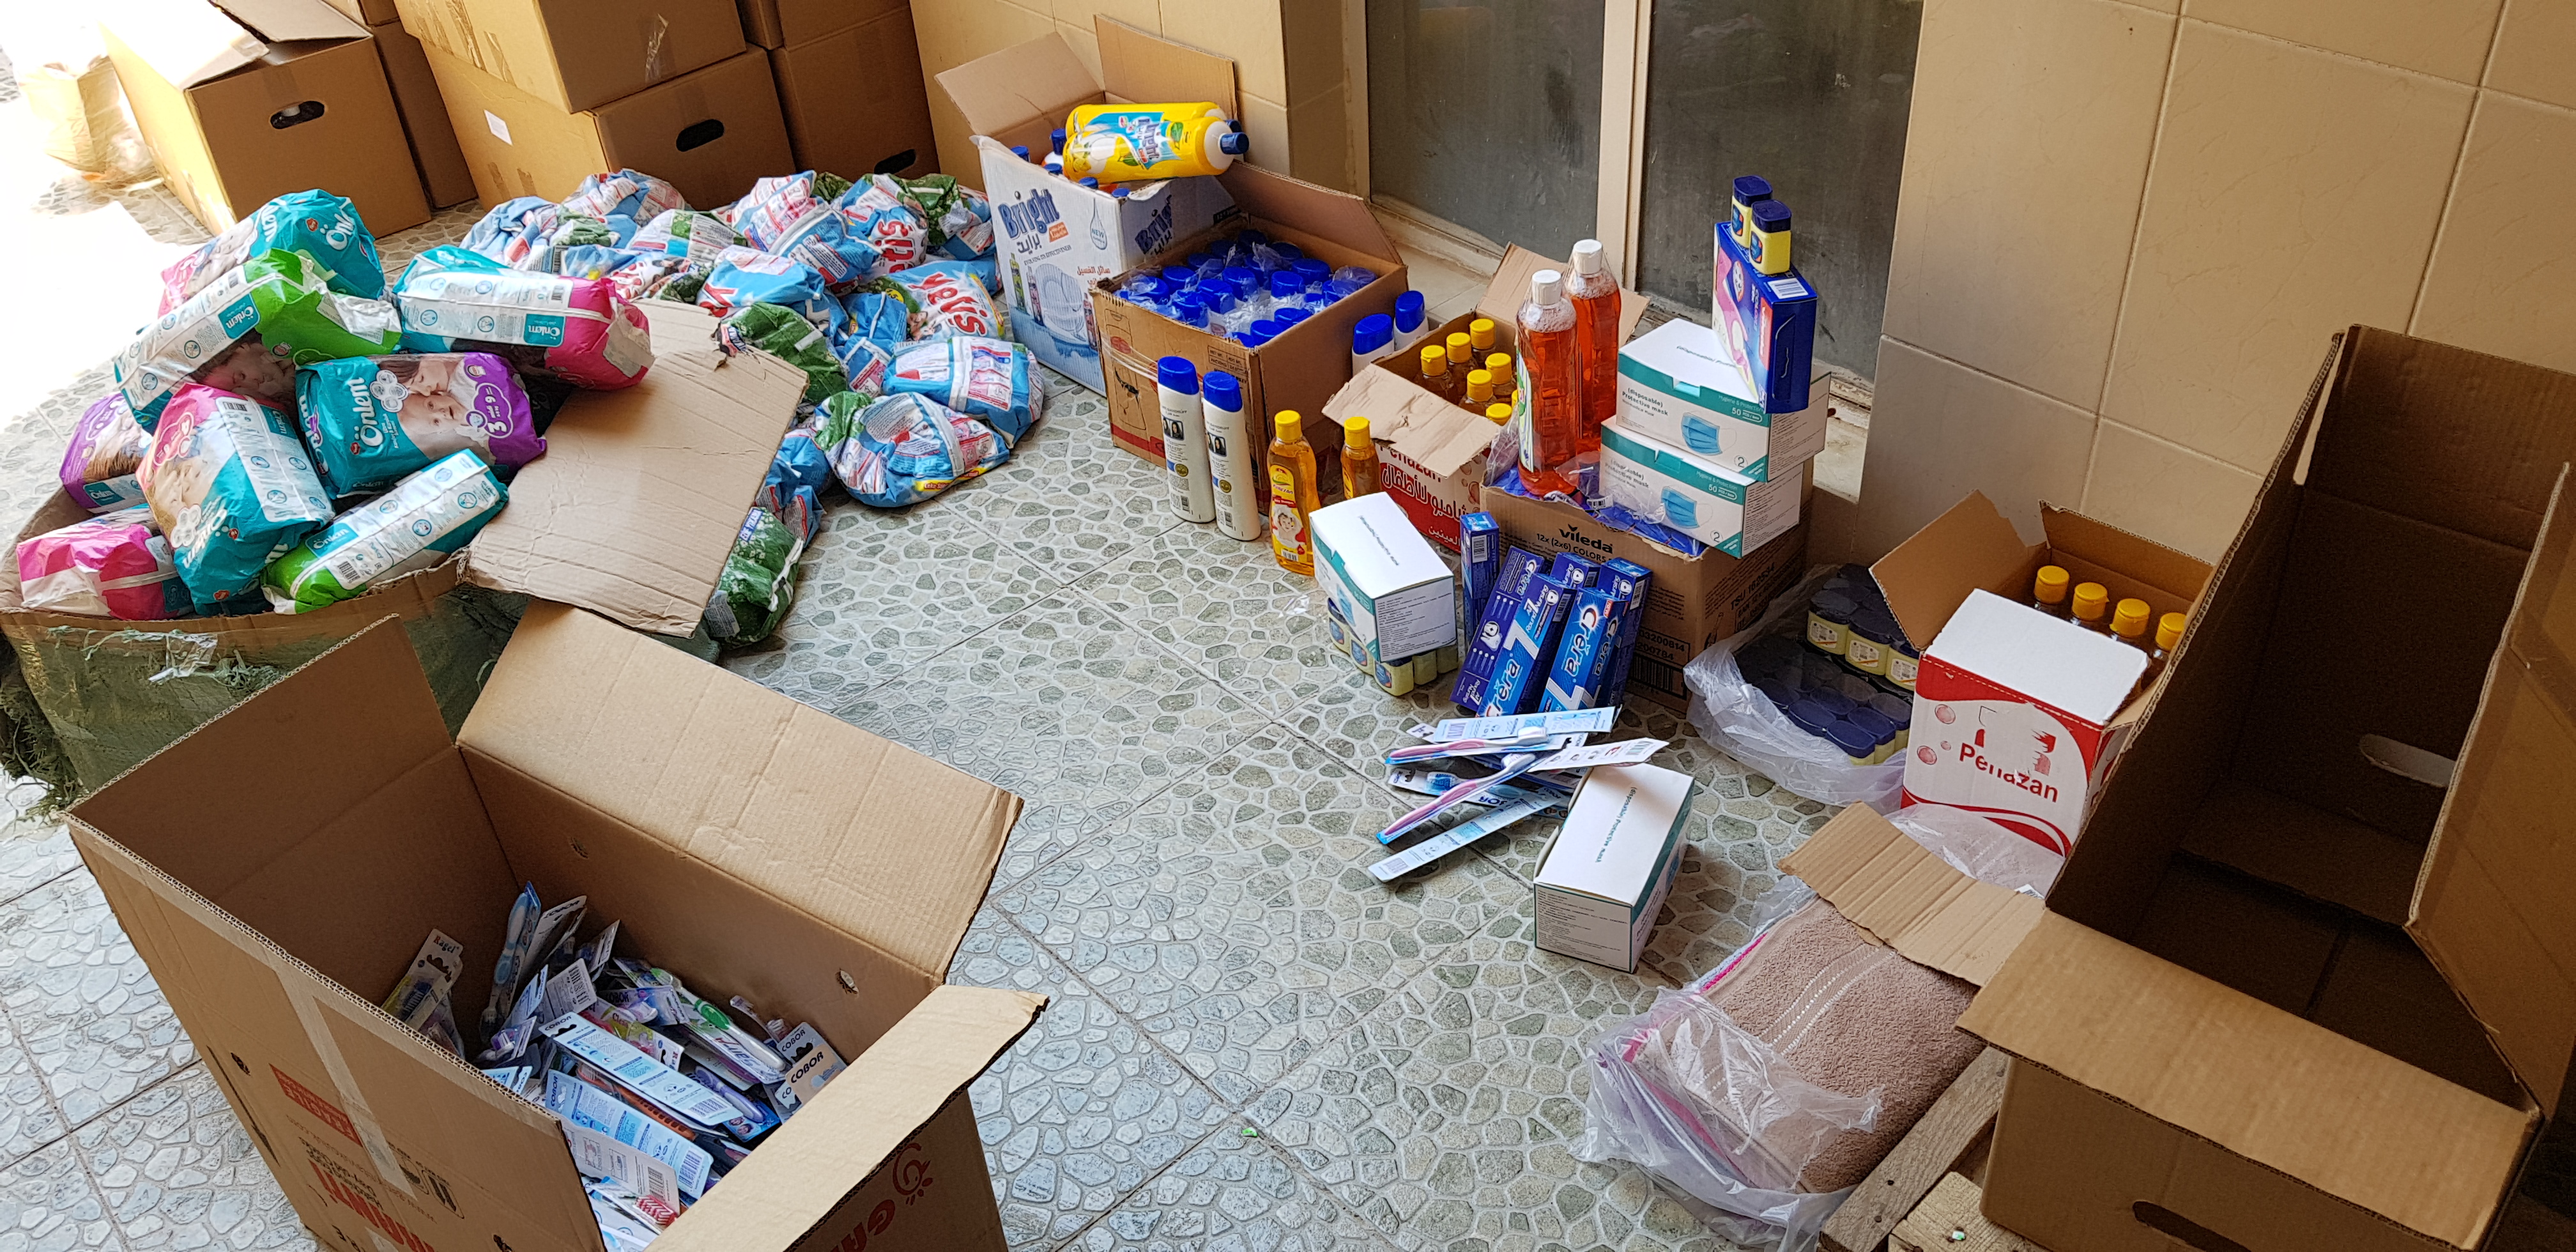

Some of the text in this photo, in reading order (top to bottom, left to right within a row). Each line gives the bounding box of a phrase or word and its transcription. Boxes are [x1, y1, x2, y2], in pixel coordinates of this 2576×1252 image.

[998, 188, 1060, 240] Bright
[1091, 228, 1105, 238] NEW
[226, 305, 255, 330] Önlem
[528, 324, 562, 341] Önlem
[484, 395, 496, 404] 9
[1621, 391, 1669, 416] Protective mask
[1627, 386, 1664, 408] (disposable)
[348, 376, 384, 447] Önlem
[1731, 408, 1742, 416] 50
[488, 421, 507, 434] 3
[1737, 455, 1745, 468] 2
[1381, 462, 1429, 505] للأطفال
[1633, 478, 1650, 489] mask
[1708, 484, 1717, 493] 50
[313, 527, 351, 550] Önlem
[1558, 523, 1613, 554] vileda
[1713, 531, 1720, 542] 2
[1536, 533, 1549, 543] 12x
[1550, 537, 1572, 553] (2x6)
[1572, 546, 1606, 563] COLORS
[433, 935, 457, 954] Ragel
[781, 1028, 806, 1053] COBOR
[790, 1050, 824, 1084] COBOR
[551, 1075, 559, 1108] COBOR
